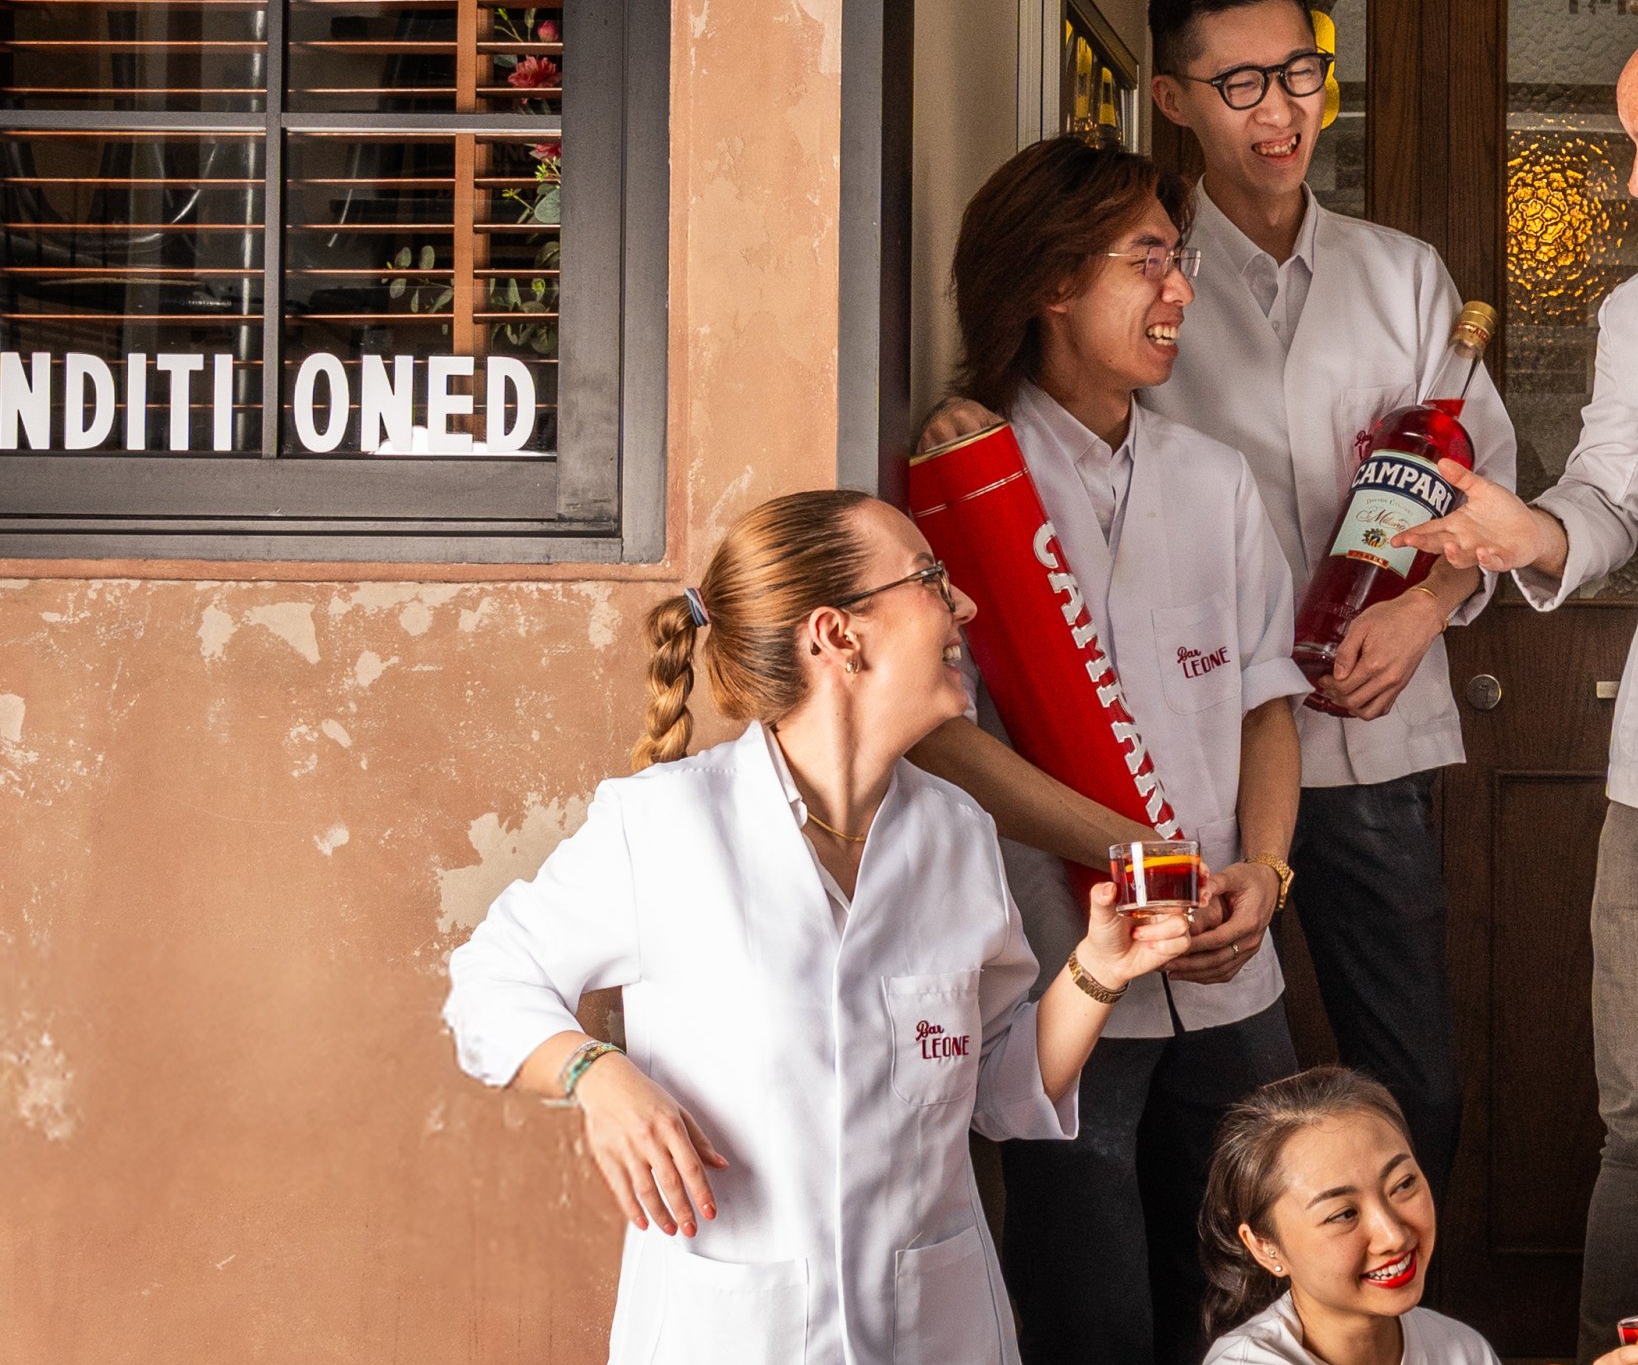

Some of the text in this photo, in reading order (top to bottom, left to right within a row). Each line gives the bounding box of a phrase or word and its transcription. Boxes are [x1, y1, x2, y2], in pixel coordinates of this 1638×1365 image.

[1352, 461, 1453, 516] CAMPARI
[1177, 646, 1202, 664] Bar
[1182, 646, 1231, 679] LEONE
[915, 1020, 945, 1041] Bar
[922, 1035, 970, 1060] LEONE
